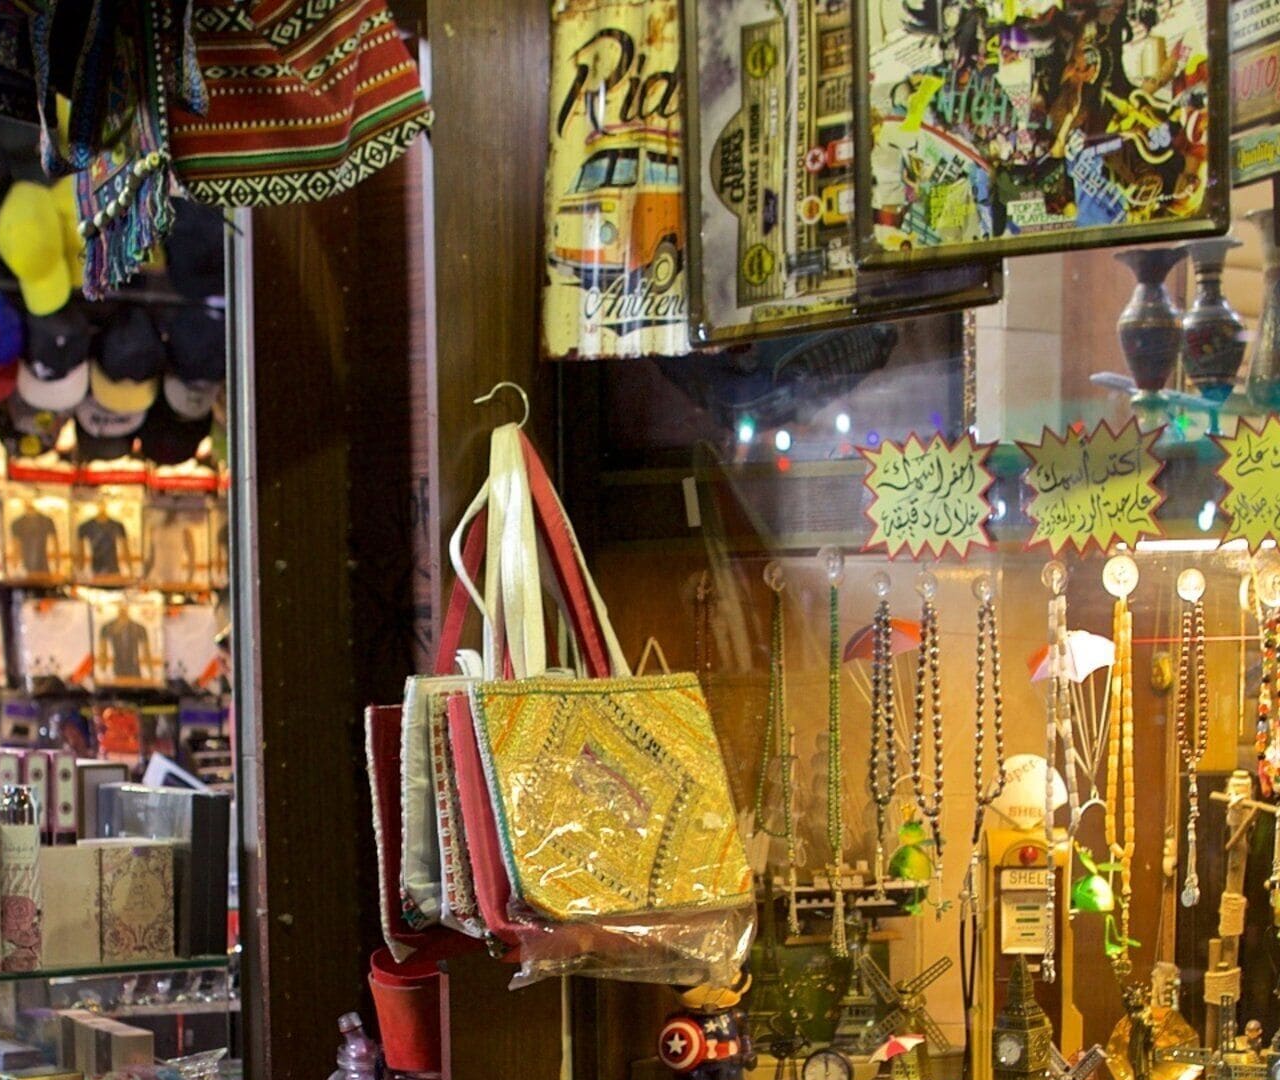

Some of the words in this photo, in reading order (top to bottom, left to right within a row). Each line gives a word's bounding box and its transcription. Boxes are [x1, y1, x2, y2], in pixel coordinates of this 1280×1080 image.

[797, 87, 807, 112] OIL
[748, 103, 761, 155] STATION
[747, 158, 760, 215] SERVICE
[796, 121, 806, 201] GASOLINE
[1008, 805, 1047, 818] SHEL
